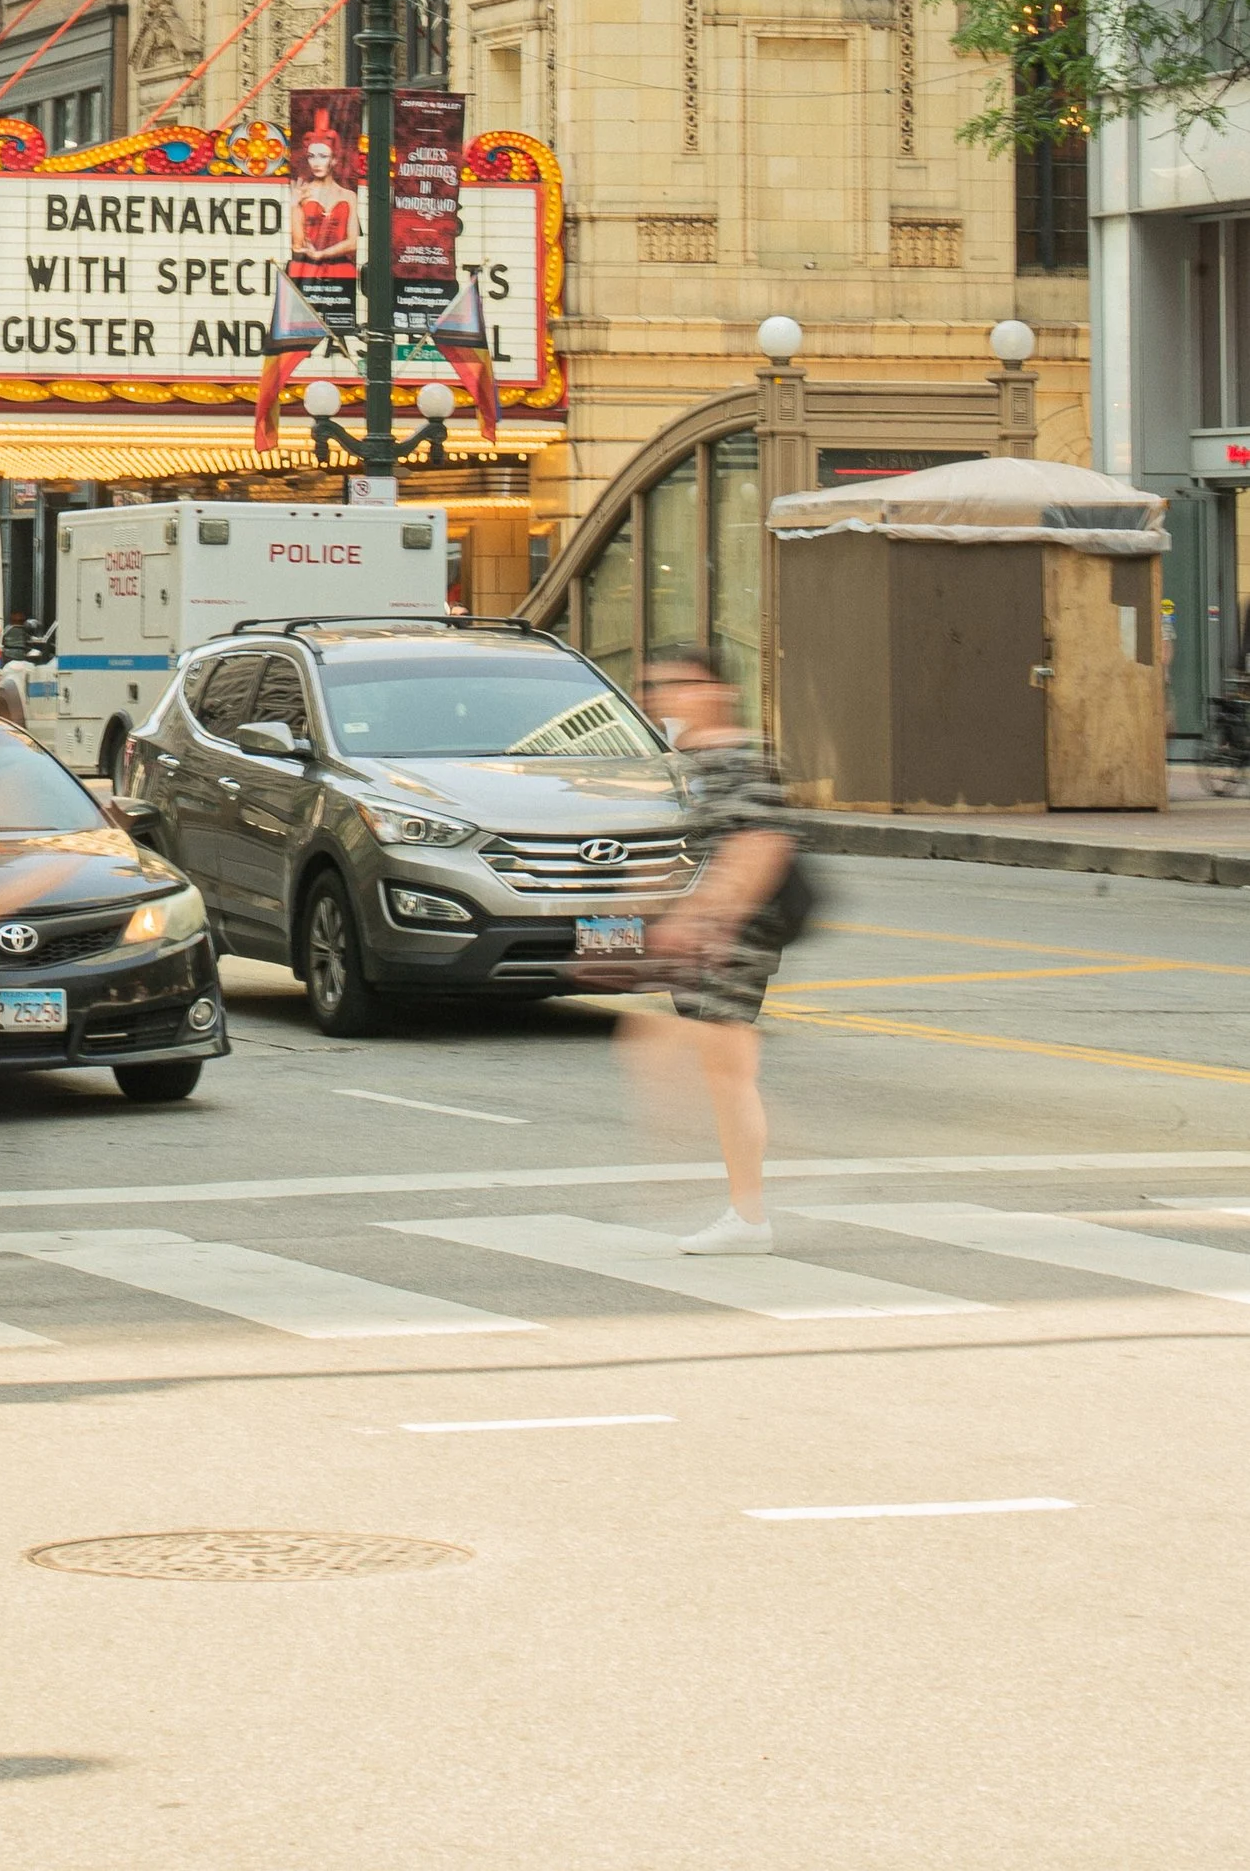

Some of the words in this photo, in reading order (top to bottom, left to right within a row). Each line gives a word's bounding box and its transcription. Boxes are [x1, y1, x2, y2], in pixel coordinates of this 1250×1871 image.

[47, 194, 282, 236] BARENAKED
[27, 256, 126, 293] WITH
[157, 258, 273, 296] SPECI
[2, 317, 155, 356] GUSTER
[188, 320, 266, 358] AND
[104, 550, 143, 573] CHICAGO
[269, 543, 362, 565] POLICE
[108, 576, 139, 597] POLICE
